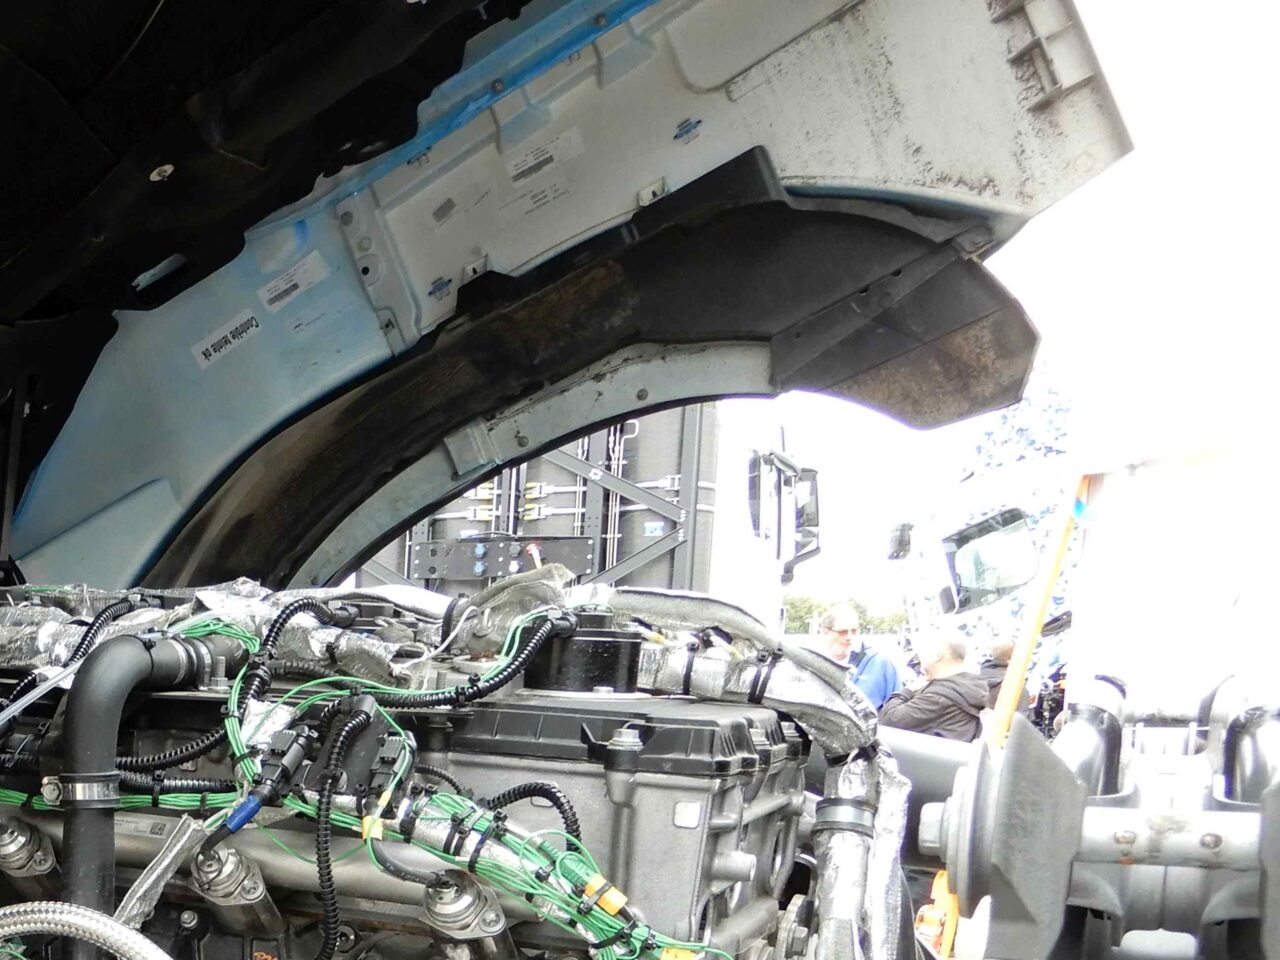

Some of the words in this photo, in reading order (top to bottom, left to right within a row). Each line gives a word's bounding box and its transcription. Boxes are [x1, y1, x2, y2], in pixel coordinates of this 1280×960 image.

[230, 315, 260, 342] Contrôle
[200, 345, 214, 362] ok
[210, 332, 233, 356] teinte
